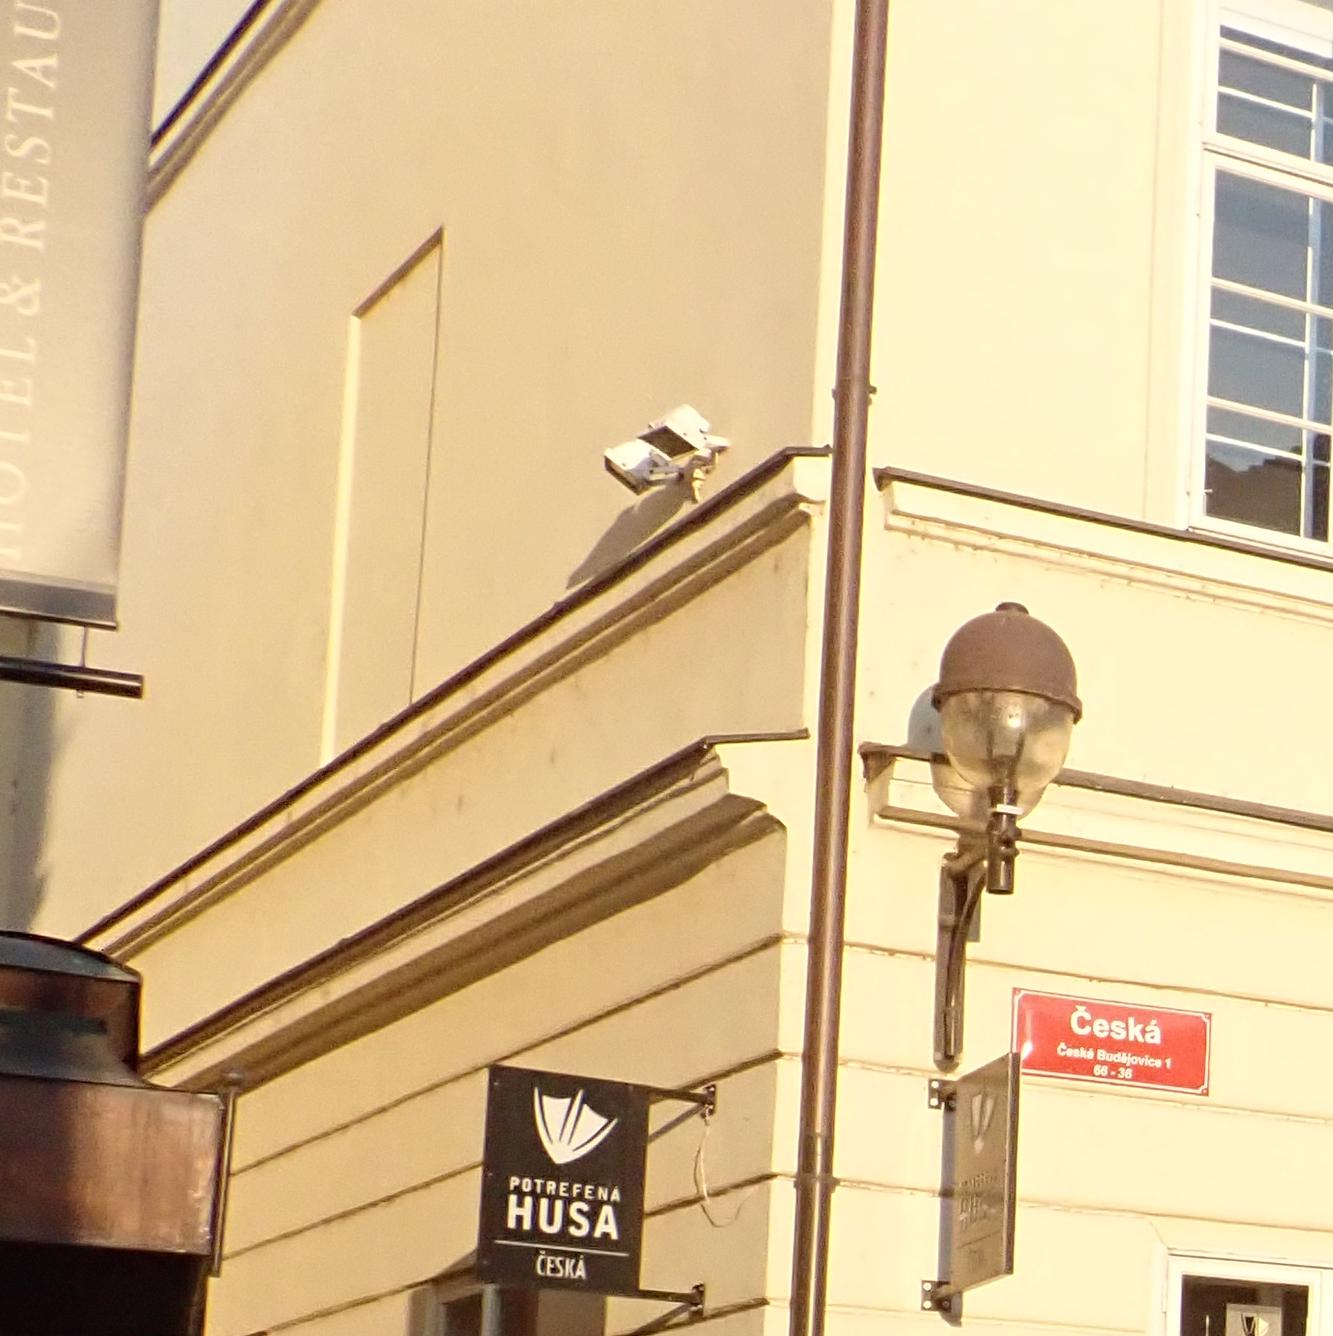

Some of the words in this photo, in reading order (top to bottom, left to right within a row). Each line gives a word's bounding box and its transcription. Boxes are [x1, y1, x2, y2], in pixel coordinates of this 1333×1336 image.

[0, 275, 41, 317] &
[1070, 1005, 1162, 1044] Česká
[1056, 1042, 1095, 1060] České
[1096, 1048, 1162, 1067] Budějovice
[1164, 1057, 1172, 1069] 1
[509, 1175, 621, 1202] POTREFENÁ
[507, 1194, 619, 1240] HUSA
[536, 1250, 587, 1280] ČESKÁ
